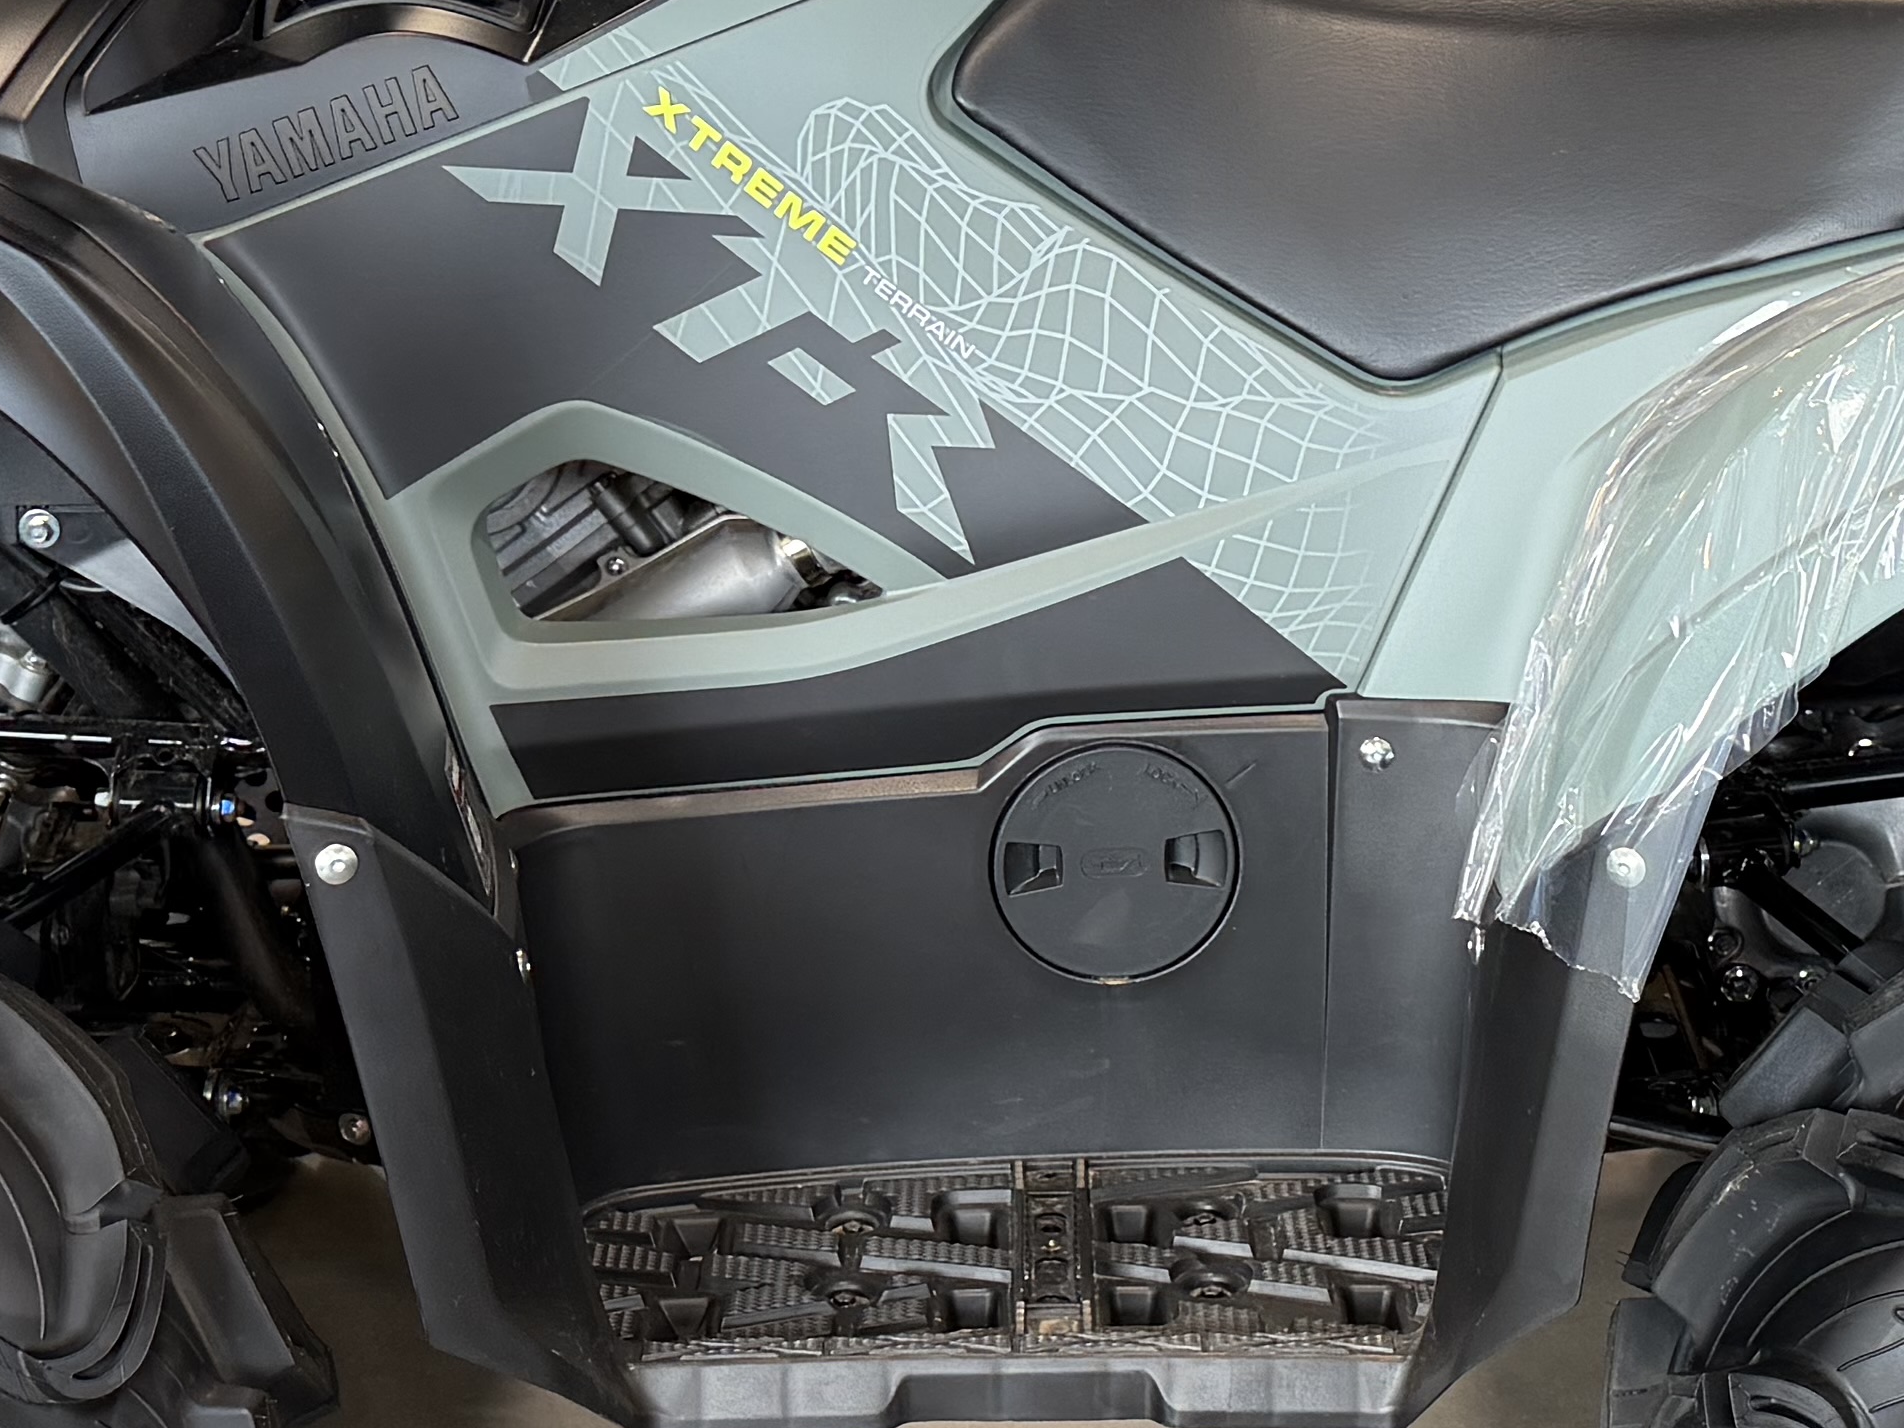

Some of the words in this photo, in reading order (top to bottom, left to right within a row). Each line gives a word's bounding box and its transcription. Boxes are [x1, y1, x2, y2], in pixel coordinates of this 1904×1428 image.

[192, 63, 462, 203] YAMAHA
[643, 86, 858, 266] XTREME
[861, 265, 978, 360] TERRAIN
